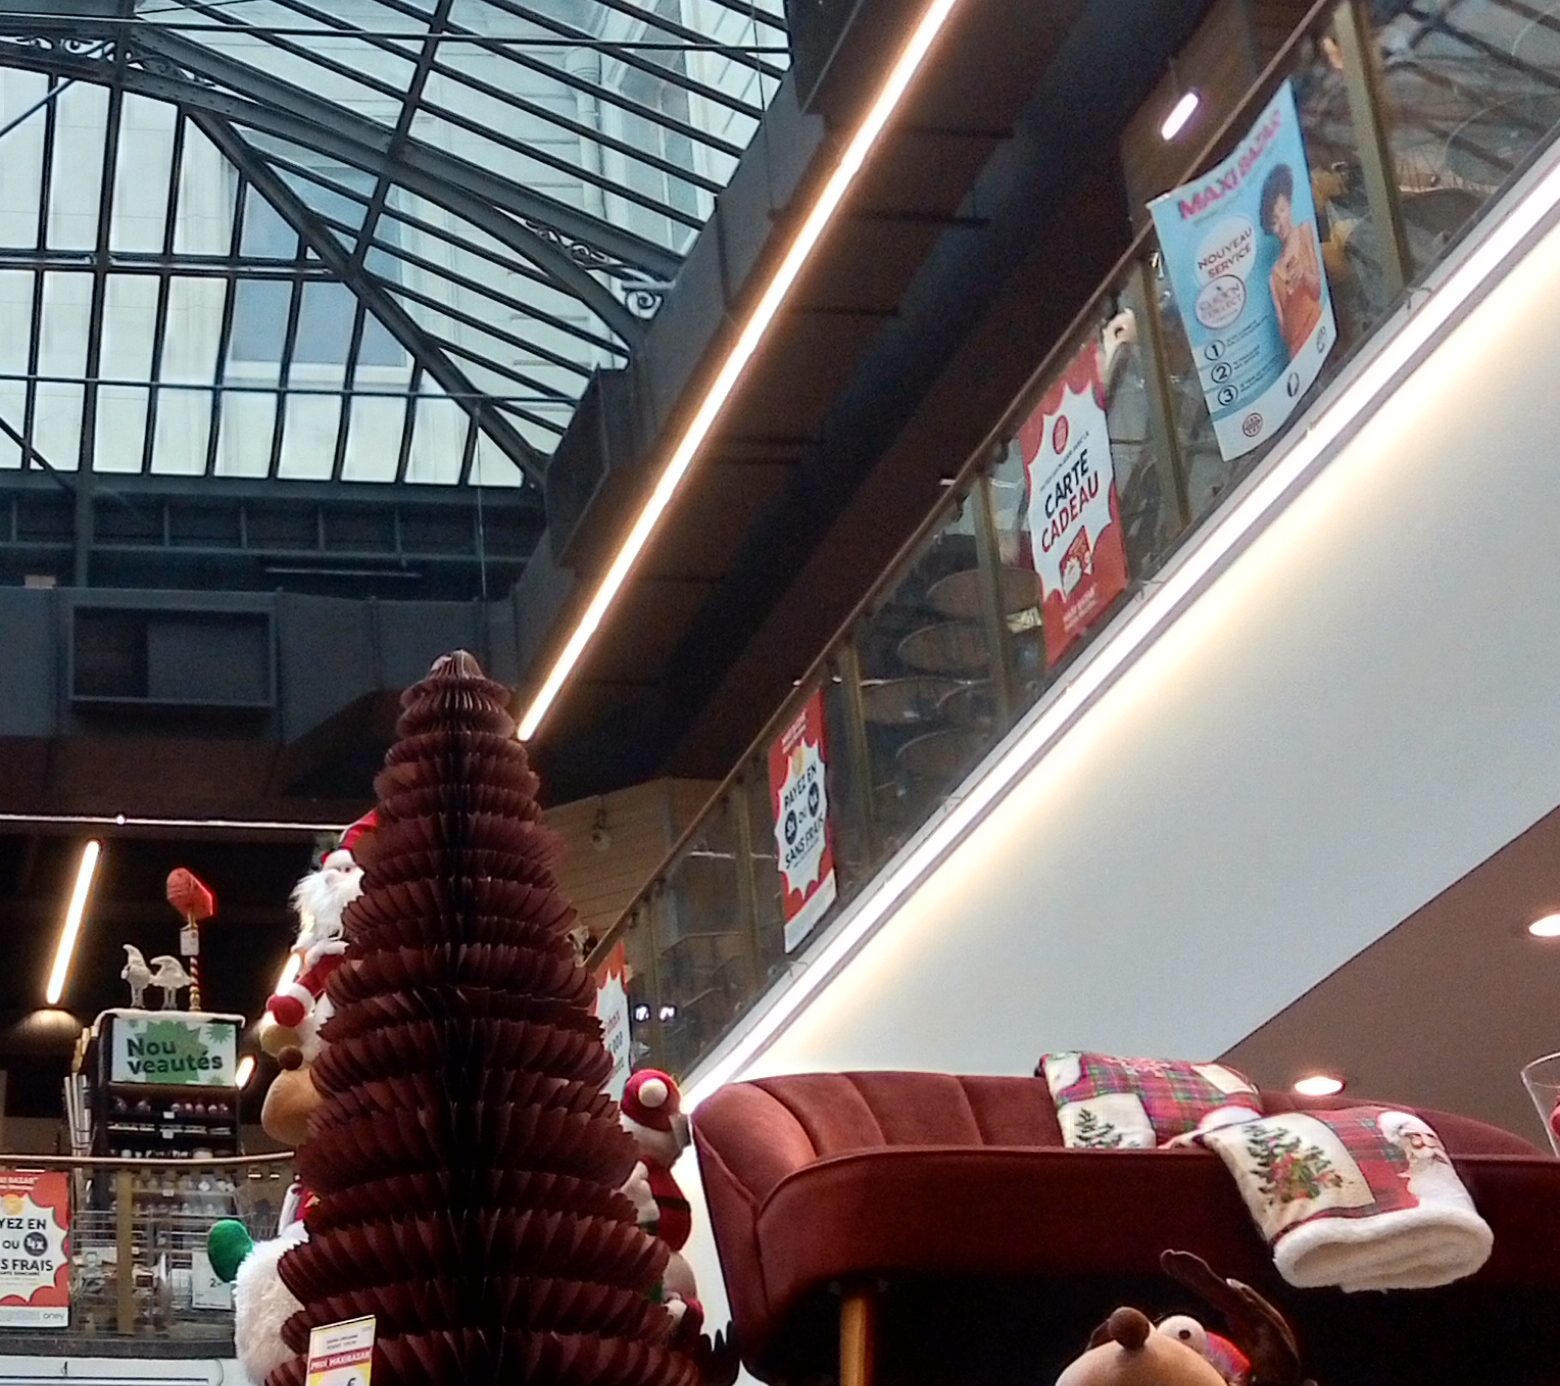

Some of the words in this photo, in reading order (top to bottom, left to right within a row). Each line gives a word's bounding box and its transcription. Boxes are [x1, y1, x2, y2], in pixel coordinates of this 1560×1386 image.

[1177, 169, 1240, 221] MAXI
[1197, 227, 1253, 271] NOUVEAU
[1208, 244, 1252, 277] SERVICE
[1044, 448, 1089, 519] CARTE
[1041, 470, 1099, 553] CADEAU
[785, 837, 805, 869] SANS
[127, 1038, 177, 1057] Nou
[127, 1049, 223, 1075] veautés
[27, 1219, 46, 1230] EN
[2, 1240, 19, 1249] OU
[27, 1238, 44, 1250] 4x
[13, 1259, 53, 1272] FRAIS
